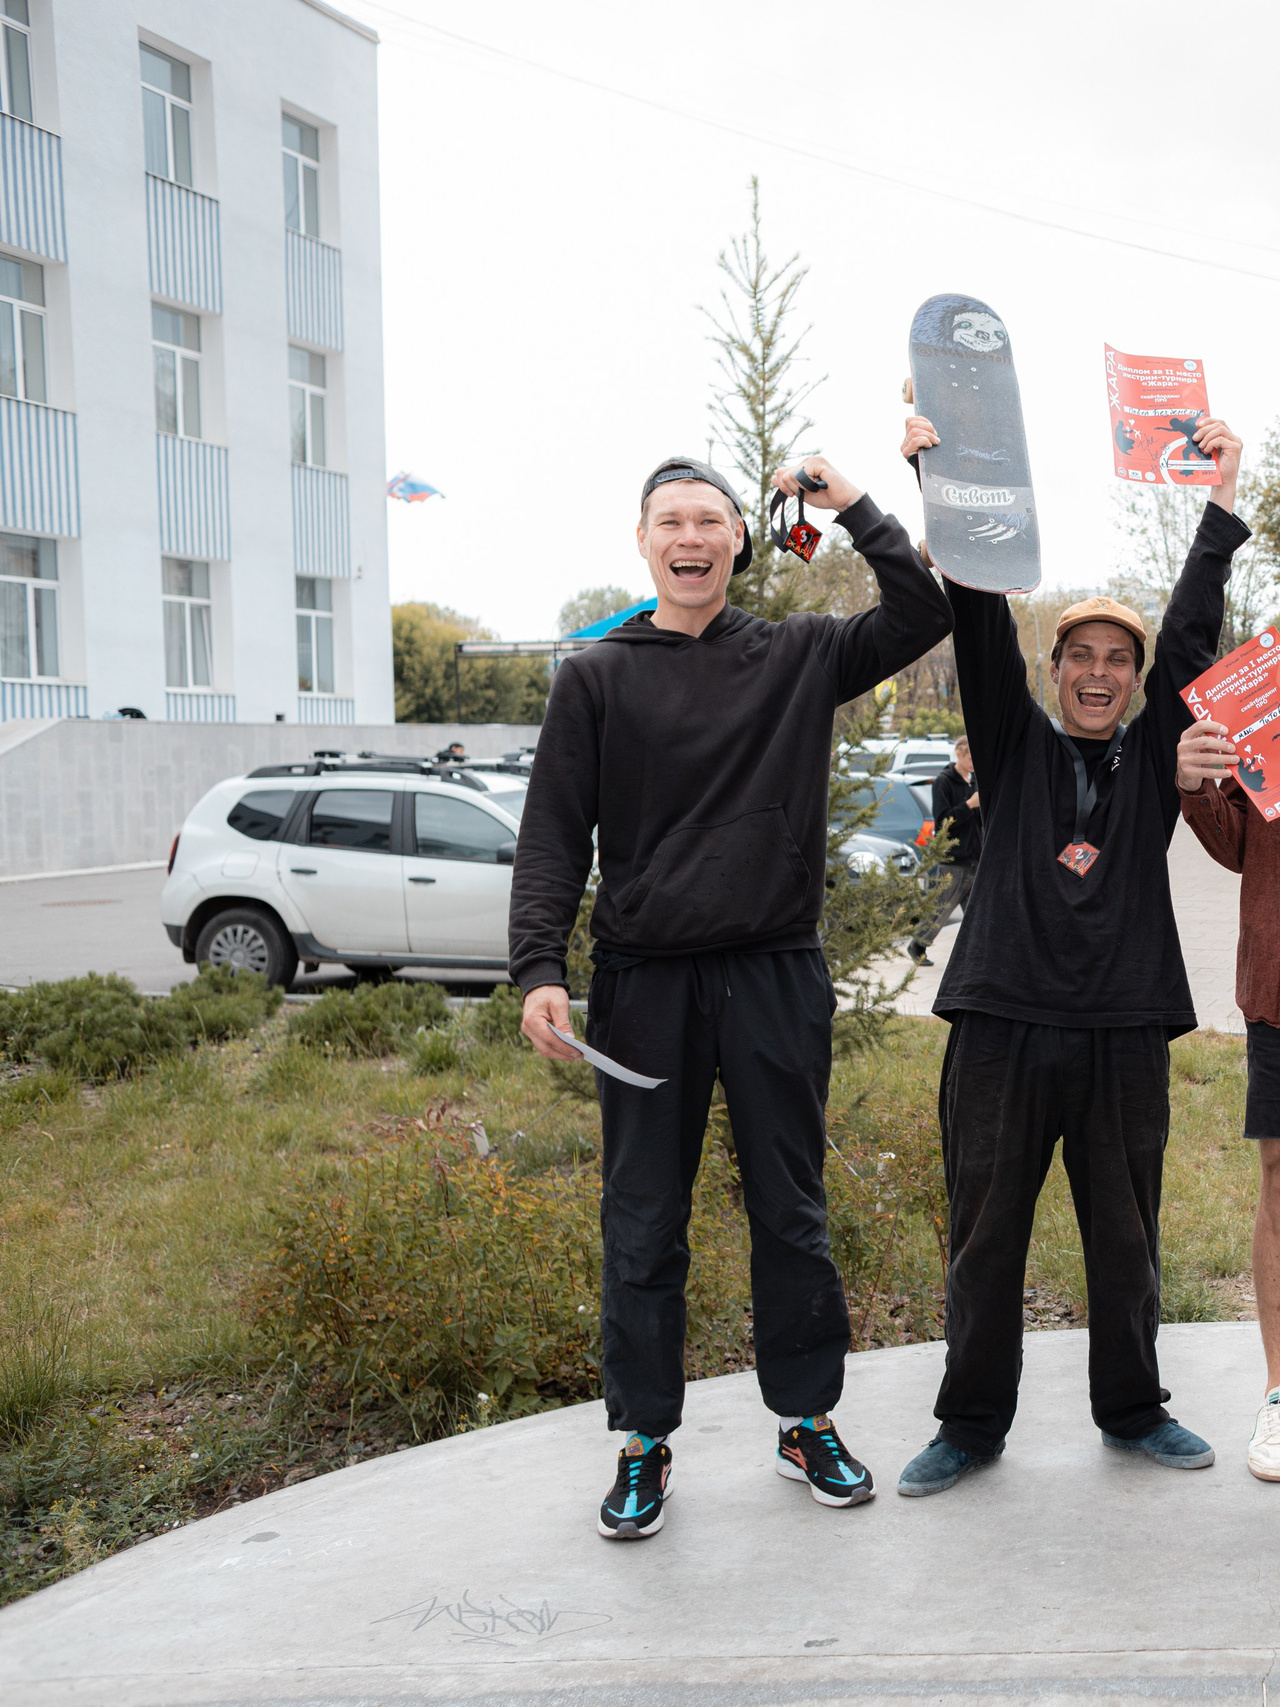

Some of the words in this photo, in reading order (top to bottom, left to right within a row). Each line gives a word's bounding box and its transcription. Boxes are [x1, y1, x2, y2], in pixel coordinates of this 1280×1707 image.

[1117, 363, 1151, 376] Диплом
[1105, 351, 1121, 412] ЖАРА
[1122, 372, 1198, 384] экстрим-турнира
[1141, 380, 1179, 388] «Жара»
[799, 529, 808, 543] 3
[1205, 672, 1238, 700] Диплом
[1238, 665, 1249, 675] за
[1233, 671, 1269, 696] «Жара»
[1240, 686, 1278, 713] скейтбординг
[1255, 698, 1268, 709] ПРО
[1075, 848, 1084, 860] 2
[1060, 857, 1086, 875] ЖАРА
